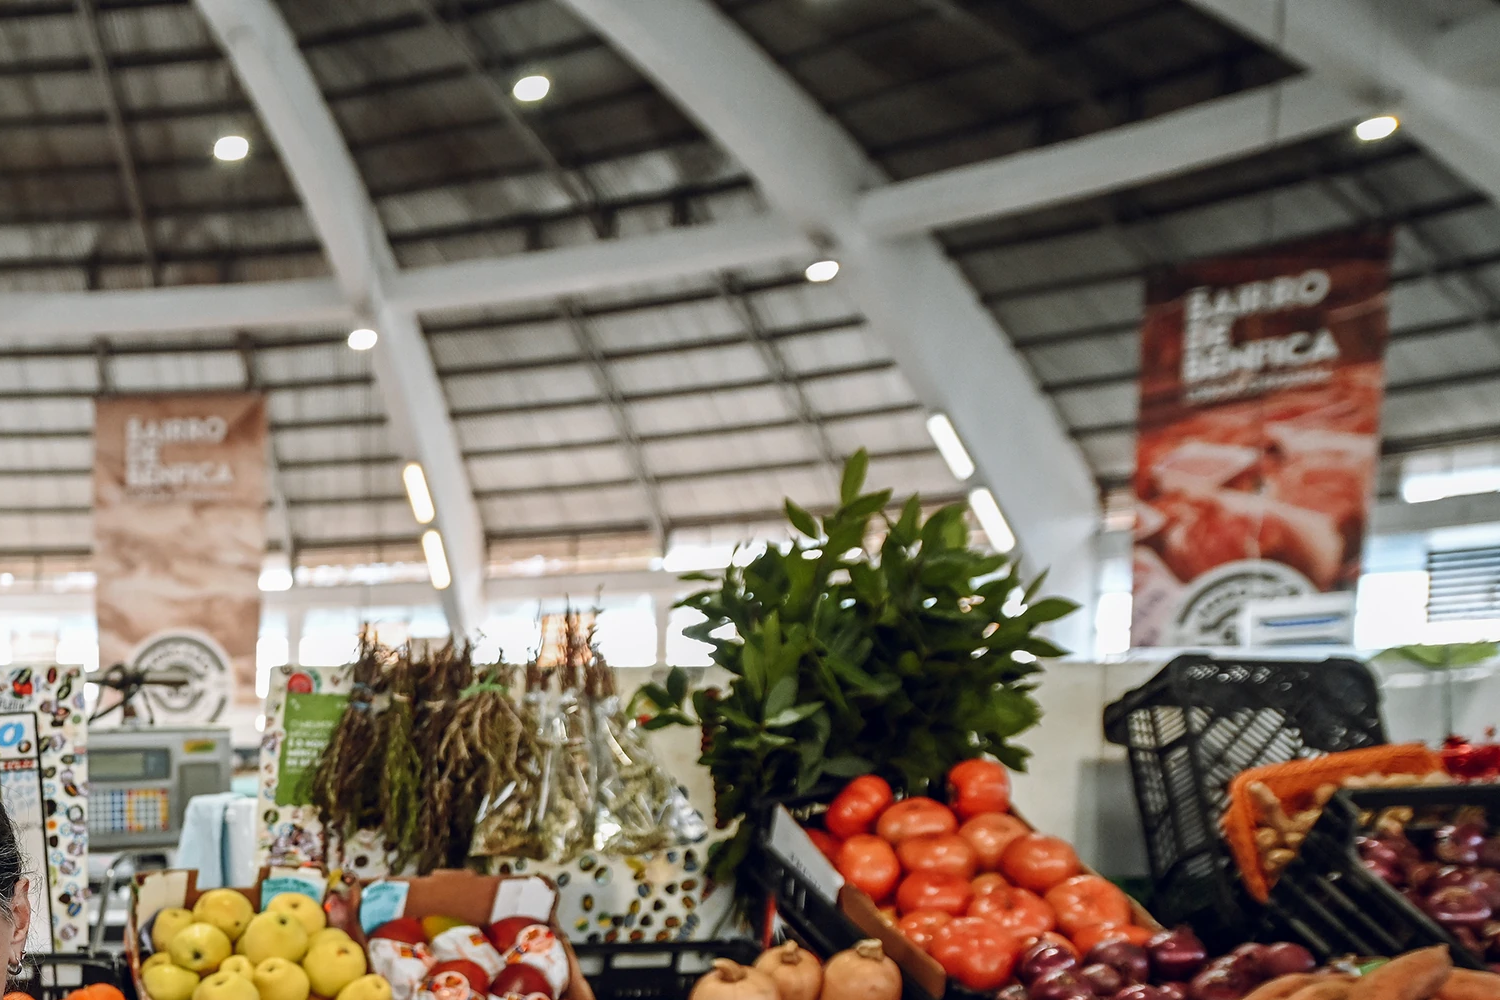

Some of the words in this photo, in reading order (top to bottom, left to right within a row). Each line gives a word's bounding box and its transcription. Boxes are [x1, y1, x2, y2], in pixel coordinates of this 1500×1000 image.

[1185, 268, 1332, 320] BAIRRO
[1181, 328, 1340, 382] BENFICA
[125, 415, 228, 444] BAIRRO
[126, 461, 234, 486] BENFICA
